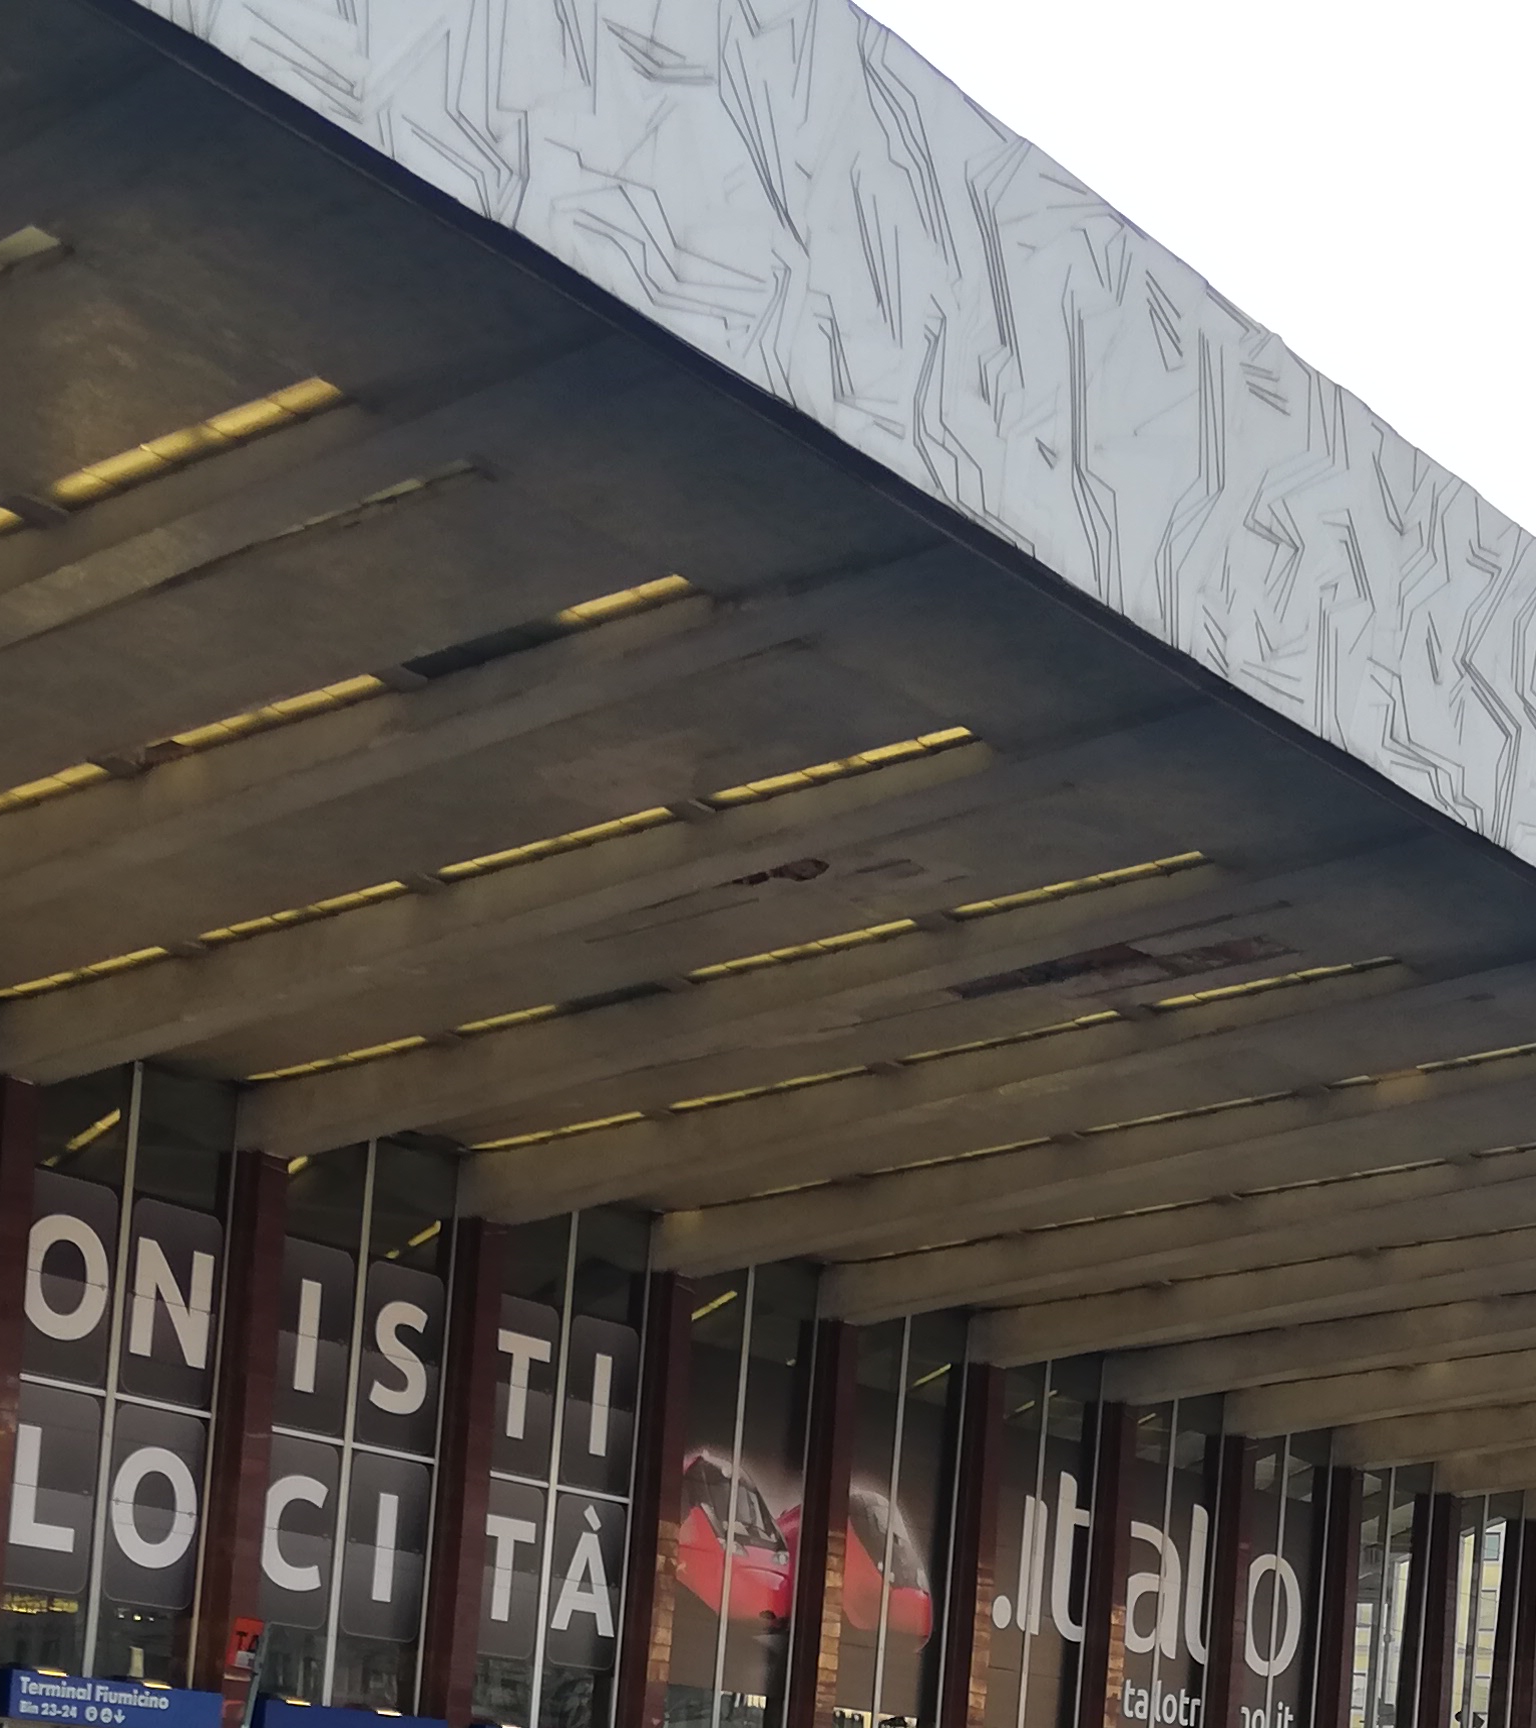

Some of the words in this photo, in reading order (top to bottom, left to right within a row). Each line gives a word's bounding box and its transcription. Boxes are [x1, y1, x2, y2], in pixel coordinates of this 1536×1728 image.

[19, 1676, 92, 1701] Terminal
[95, 1687, 170, 1710] Fiumicino
[19, 1700, 39, 1714] Bin
[41, 1702, 77, 1719] 23-24
